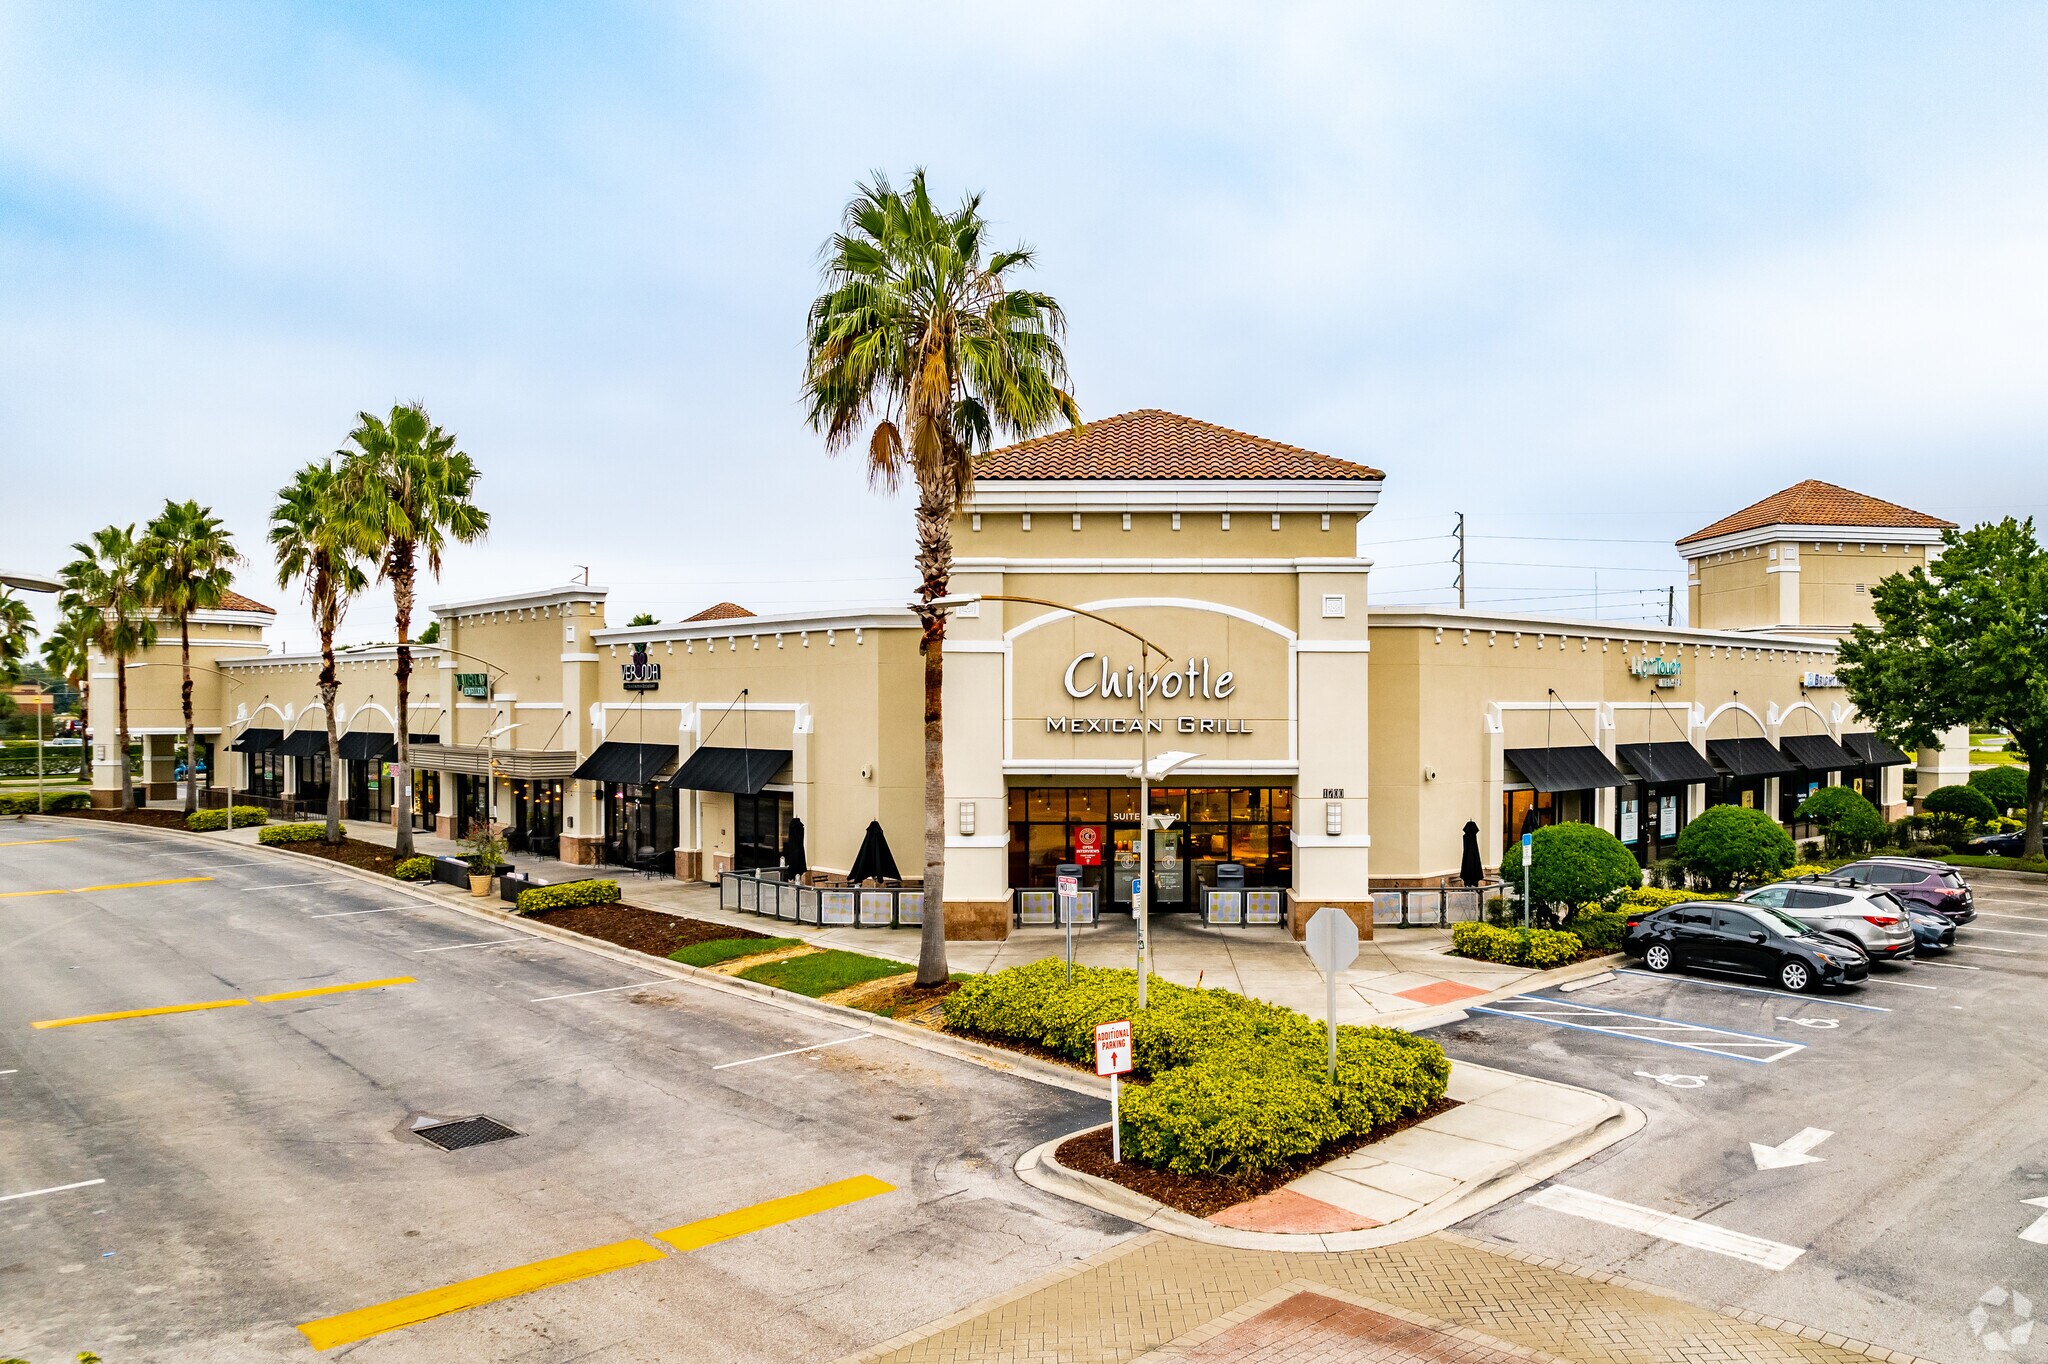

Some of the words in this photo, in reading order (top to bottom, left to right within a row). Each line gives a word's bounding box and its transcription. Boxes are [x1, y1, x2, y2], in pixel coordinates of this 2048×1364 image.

[1064, 651, 1236, 712] Chipotle
[1046, 716, 1162, 733] MEXICAN
[1177, 716, 1253, 733] GRILL
[1113, 812, 1140, 821] SUITE
[1098, 1029, 1129, 1041] ADDITIONAL
[1102, 1039, 1125, 1050] PARKING
